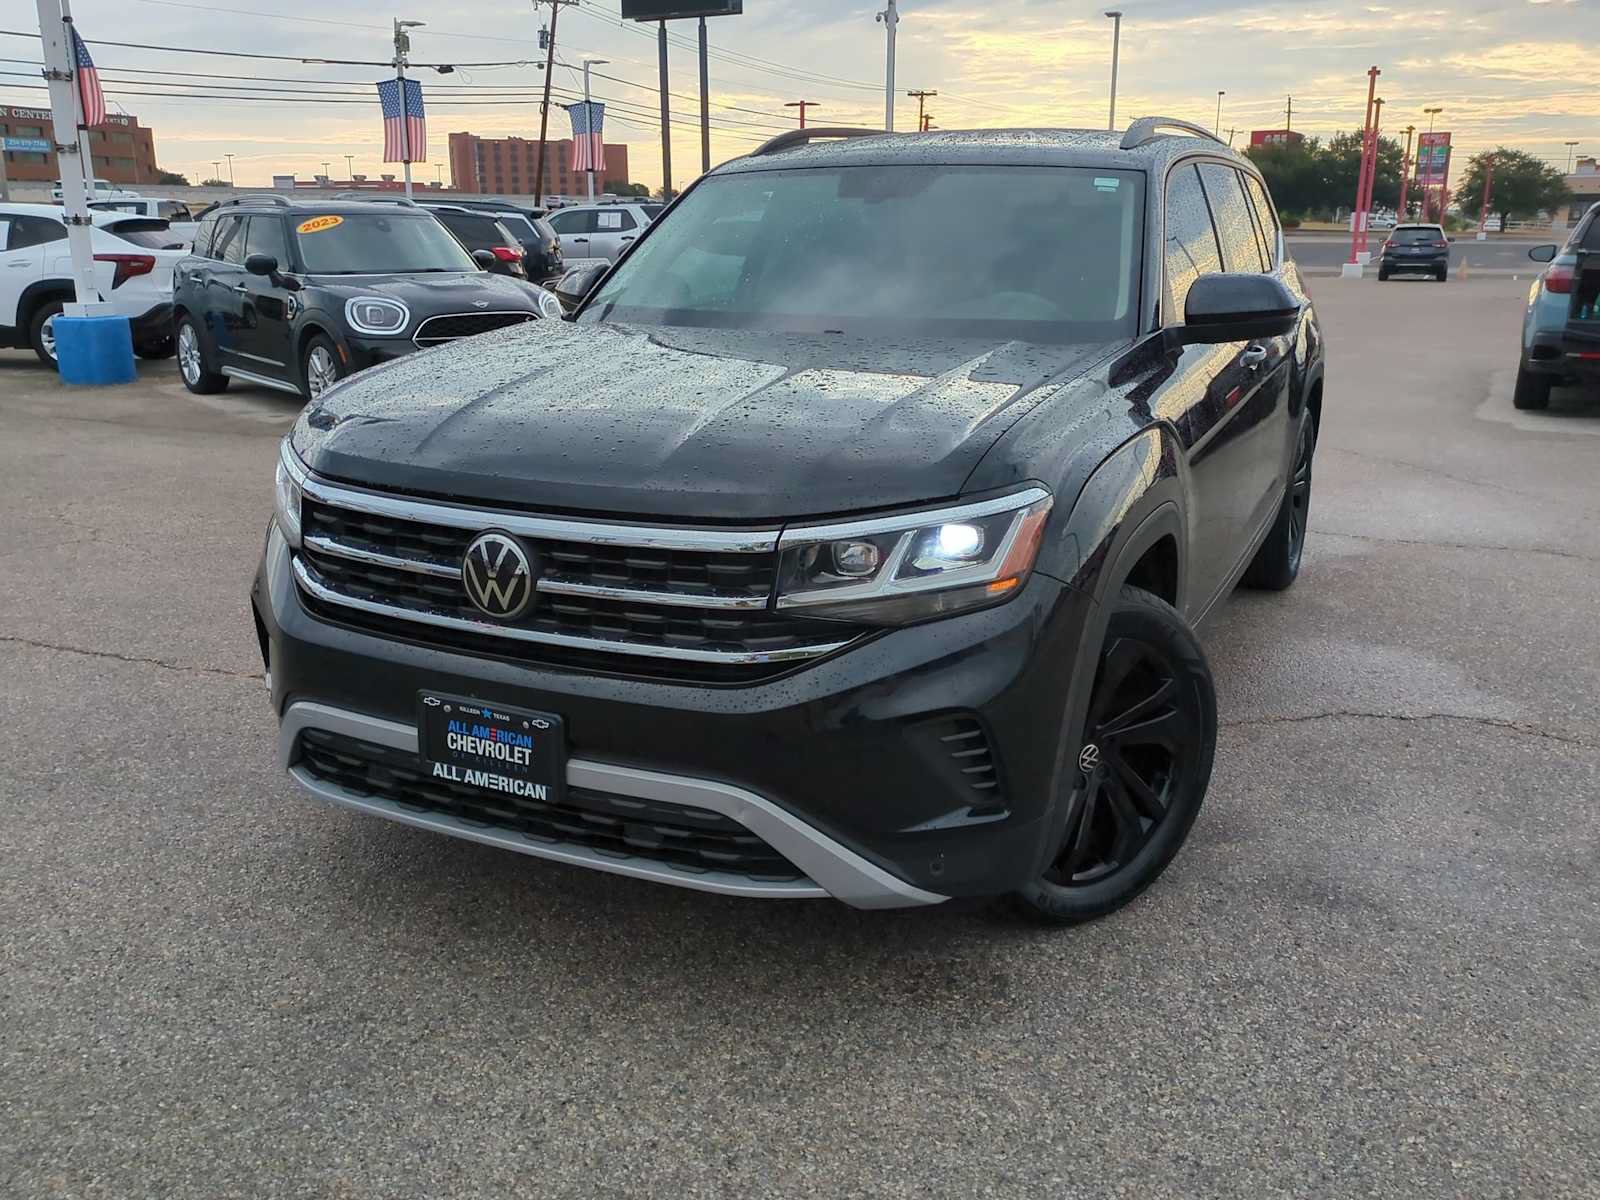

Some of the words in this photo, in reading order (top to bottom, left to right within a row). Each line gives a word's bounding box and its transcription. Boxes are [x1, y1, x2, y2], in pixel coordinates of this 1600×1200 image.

[303, 216, 338, 231] 2023
[464, 535, 530, 616] VW
[493, 713, 510, 722] TEXAS
[447, 733, 532, 765] CHEVROLET
[448, 720, 471, 735] ALL
[472, 725, 533, 748] AMERICAN
[432, 762, 462, 782] ALL
[464, 769, 547, 801] AMERICAN
